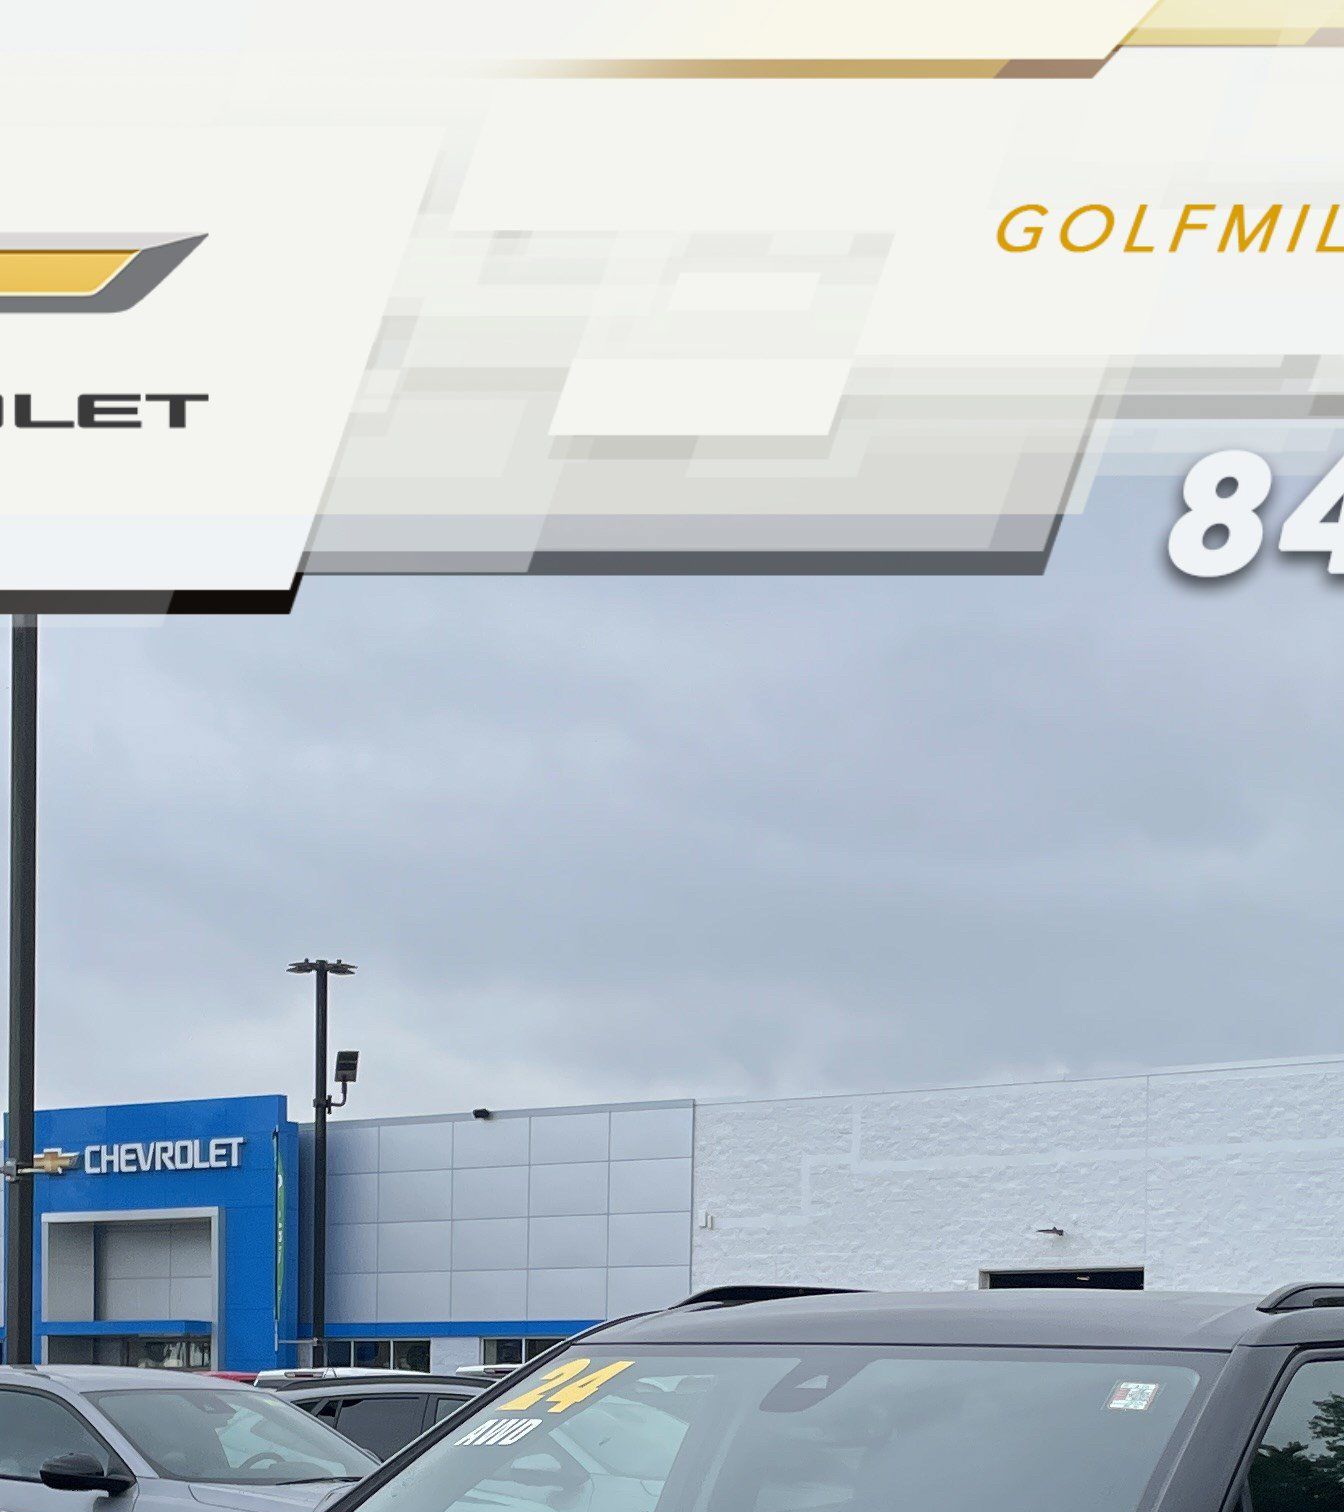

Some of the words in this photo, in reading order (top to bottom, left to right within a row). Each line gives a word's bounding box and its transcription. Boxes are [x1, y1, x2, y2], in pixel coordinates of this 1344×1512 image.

[84, 1136, 246, 1175] CHEVROLET
[495, 1358, 637, 1413] 24
[453, 1418, 543, 1446] AWD
